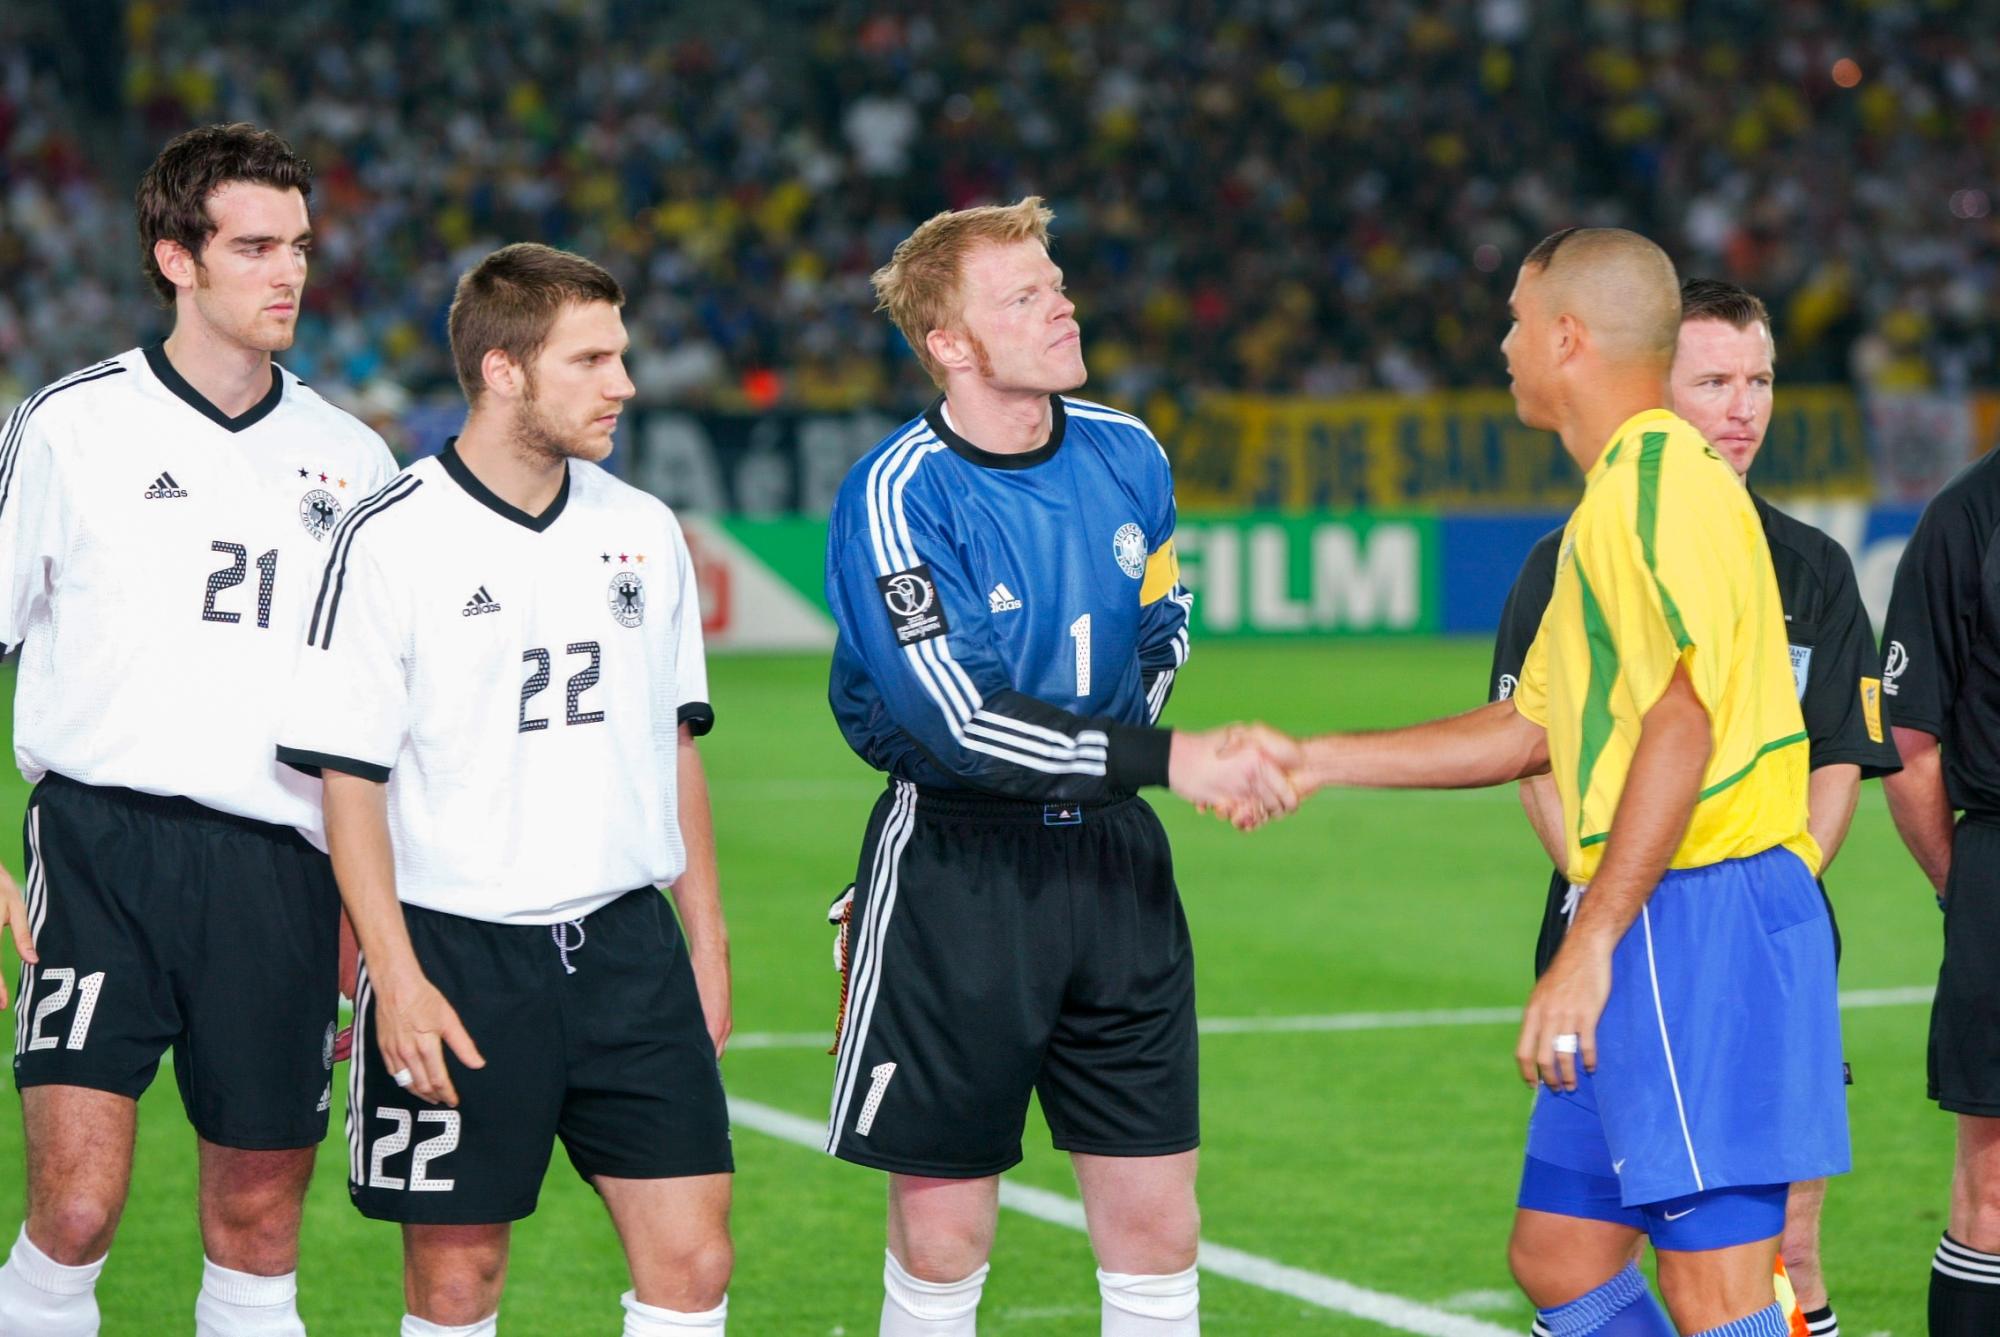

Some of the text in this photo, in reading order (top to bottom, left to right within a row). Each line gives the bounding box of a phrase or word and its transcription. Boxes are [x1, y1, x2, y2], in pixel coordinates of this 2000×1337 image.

[202, 540, 278, 629] 21
[463, 602, 502, 617] adidas
[518, 641, 605, 734] 22
[1069, 612, 1091, 698] 1
[27, 967, 106, 1052] 21
[855, 1061, 898, 1137] 1
[368, 1106, 462, 1192] 22
